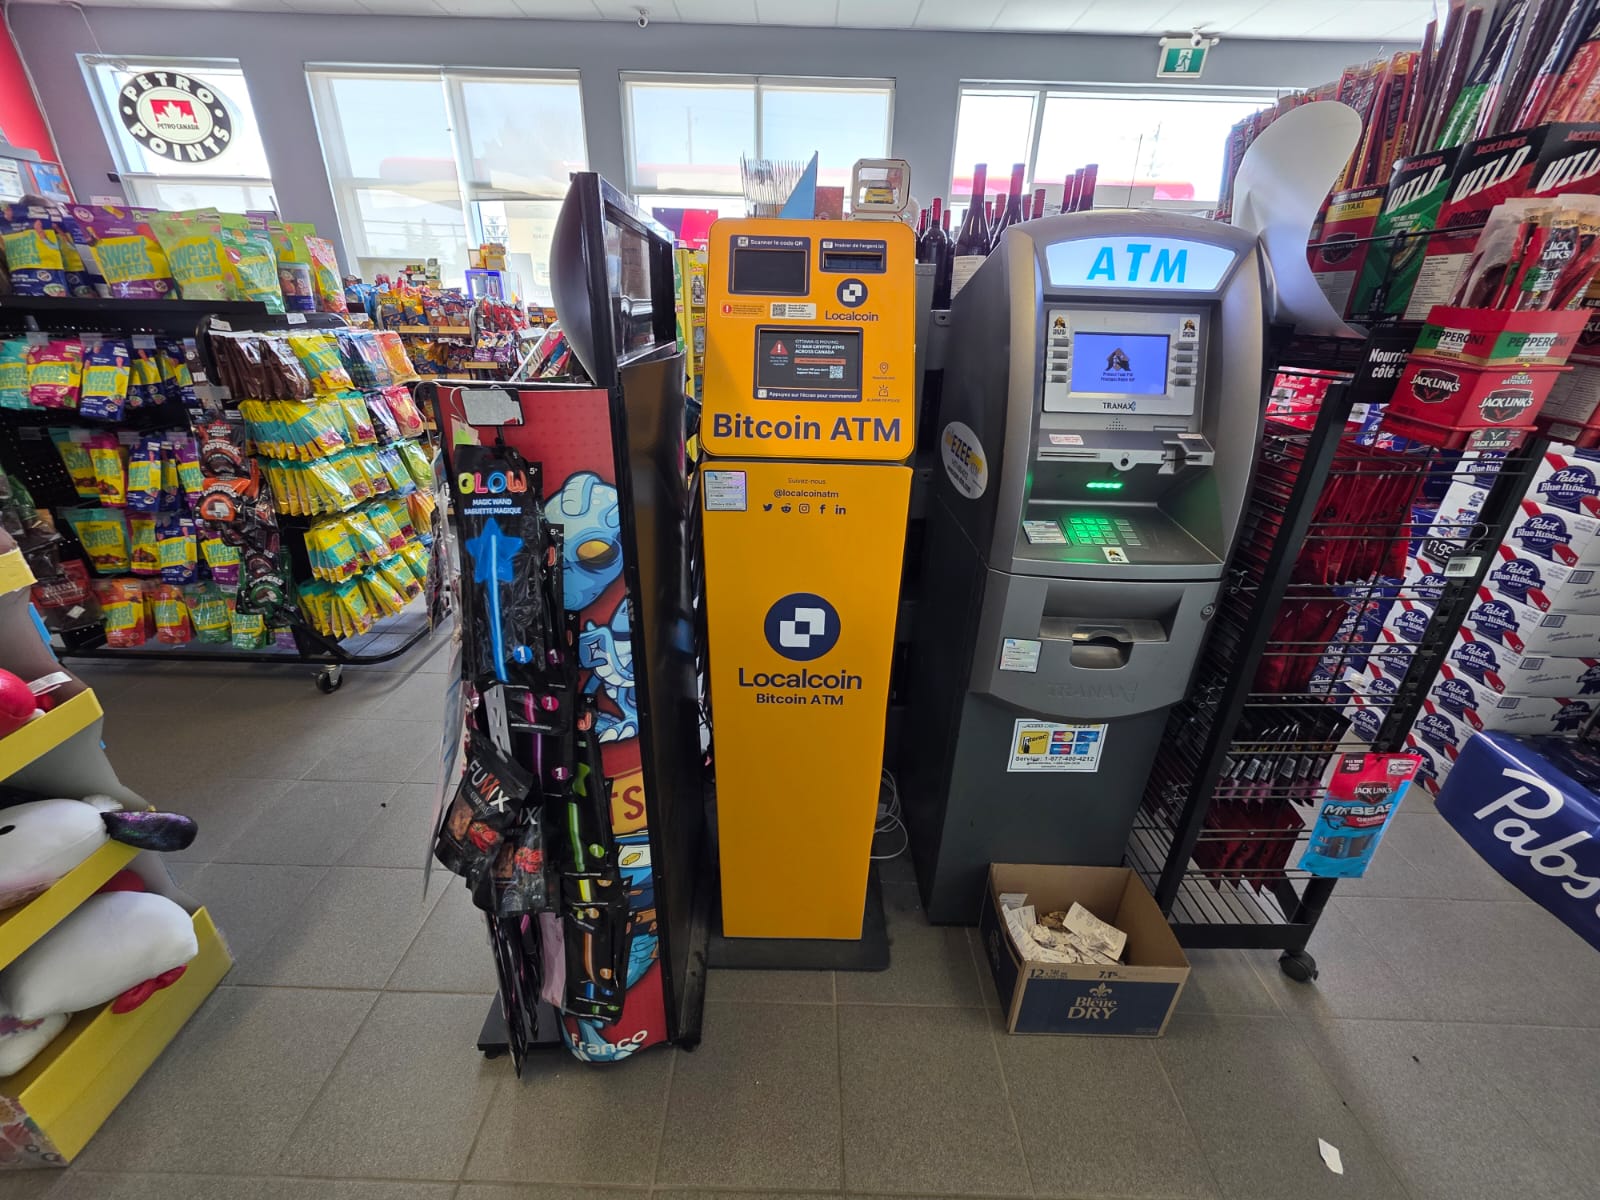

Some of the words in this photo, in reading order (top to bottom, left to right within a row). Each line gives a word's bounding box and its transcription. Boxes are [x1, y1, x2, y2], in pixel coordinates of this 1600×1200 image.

[123, 72, 214, 104] PETRO
[129, 122, 230, 161] POINTS
[1450, 145, 1532, 205] WILD
[1384, 164, 1447, 216] WILD
[1547, 241, 1571, 251] JACK
[96, 236, 149, 271] Sweet
[1086, 243, 1188, 283] ATM
[825, 310, 879, 322] Localcoin
[1426, 328, 1486, 346] PEPPERONI
[1508, 336, 1569, 348] PEPPERONI
[1372, 365, 1395, 378] côté
[1410, 373, 1433, 385] JACK
[1433, 376, 1460, 392] LINK'S
[1102, 401, 1136, 411] TRANAX
[1478, 397, 1504, 408] JACK
[1504, 397, 1534, 407] LINK'S
[713, 412, 821, 440] Bitcoin
[829, 417, 901, 443] ATM
[951, 434, 972, 467] EZEE
[788, 477, 826, 485] Suivez-nous
[1556, 470, 1588, 483] Pabst
[773, 489, 839, 499] @localcoinatm
[1541, 482, 1561, 491] Blue
[1562, 483, 1596, 494] Ribbon
[472, 498, 491, 506] MAGIC
[492, 498, 512, 506] WAND
[493, 506, 522, 515] MAGIQUE
[1530, 517, 1560, 531] Pabst
[1516, 528, 1535, 537] Blue
[1506, 561, 1534, 576] Pabst
[1425, 575, 1448, 587] Pabst
[1492, 571, 1510, 581] Blue
[1405, 610, 1425, 625] Pabst
[1483, 603, 1509, 618] Pabst
[1465, 643, 1490, 659] Pabst
[738, 668, 863, 690] Localcoin
[1375, 680, 1393, 694] Pabst
[1444, 681, 1470, 697] Pabst
[756, 693, 807, 705] Bitcoin
[810, 694, 844, 706] ATM
[1427, 715, 1451, 732] Pabst
[556, 767, 563, 779] 1
[469, 759, 510, 814] FUMIX
[1353, 786, 1372, 794] JACK
[1474, 768, 1600, 912] Pabs
[1030, 968, 1044, 978] 12
[1075, 996, 1117, 1007] Bleue
[1067, 1006, 1118, 1019] DRY
[571, 1030, 648, 1056] Franco
